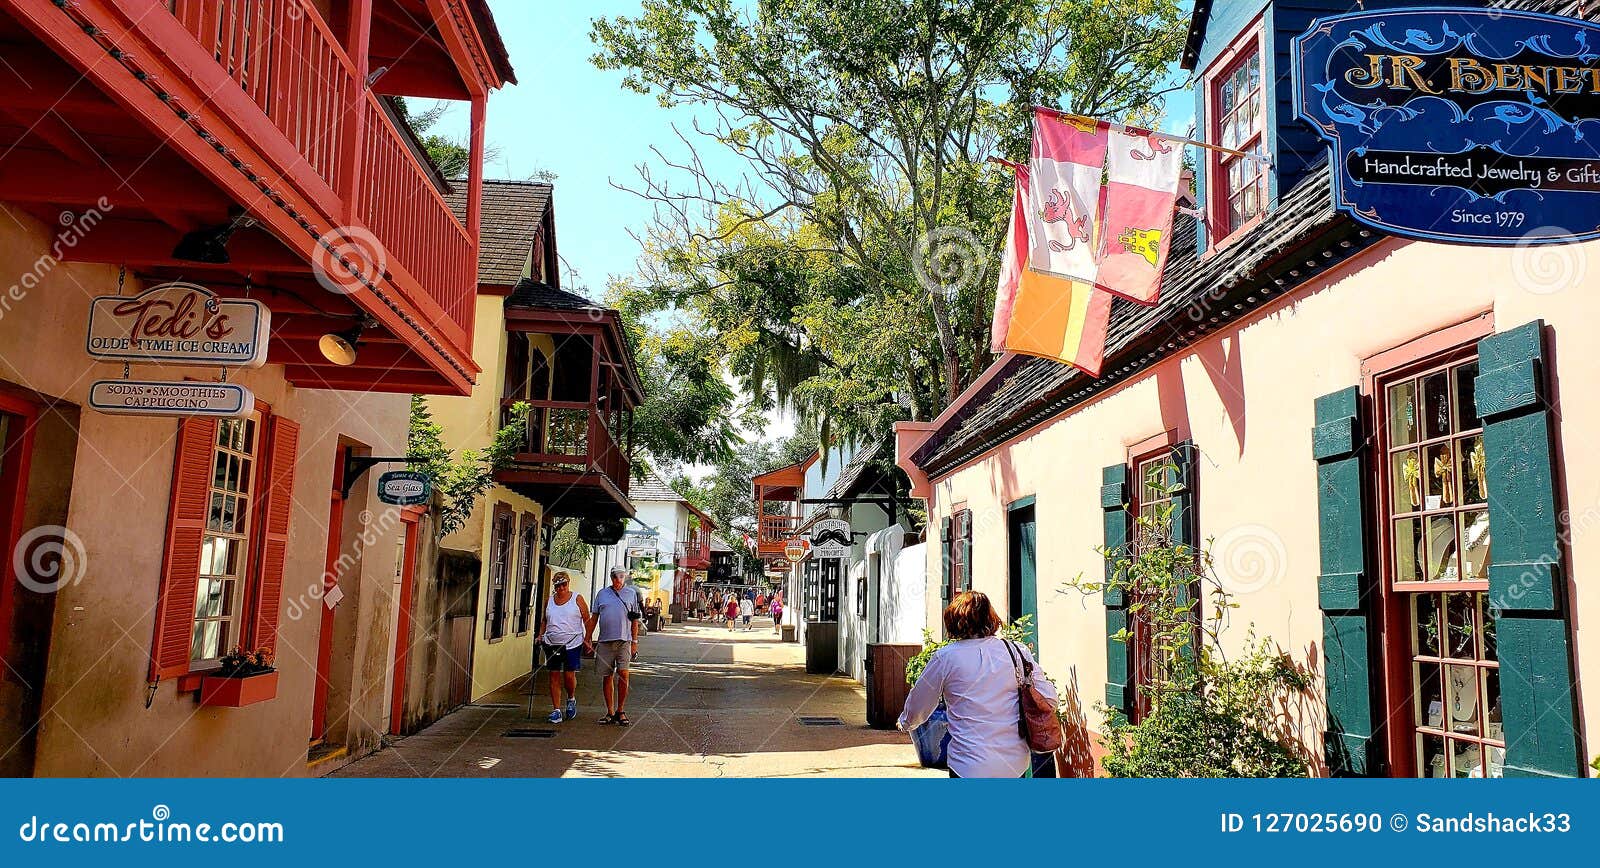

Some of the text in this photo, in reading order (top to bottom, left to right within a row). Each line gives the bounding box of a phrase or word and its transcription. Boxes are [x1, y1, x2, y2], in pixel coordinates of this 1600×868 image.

[1344, 54, 1444, 95] J.R.
[1364, 156, 1473, 180] Handcrafted
[1477, 161, 1543, 188] Jewelry
[1547, 167, 1560, 182] &
[1451, 210, 1525, 228] Since 1979
[91, 338, 250, 355] OLDE TYME ICE CREAM
[106, 385, 226, 399] SODAS SMOOTHIES
[124, 397, 209, 409] CAPPUCCINO
[386, 482, 422, 492] Sea Glass
